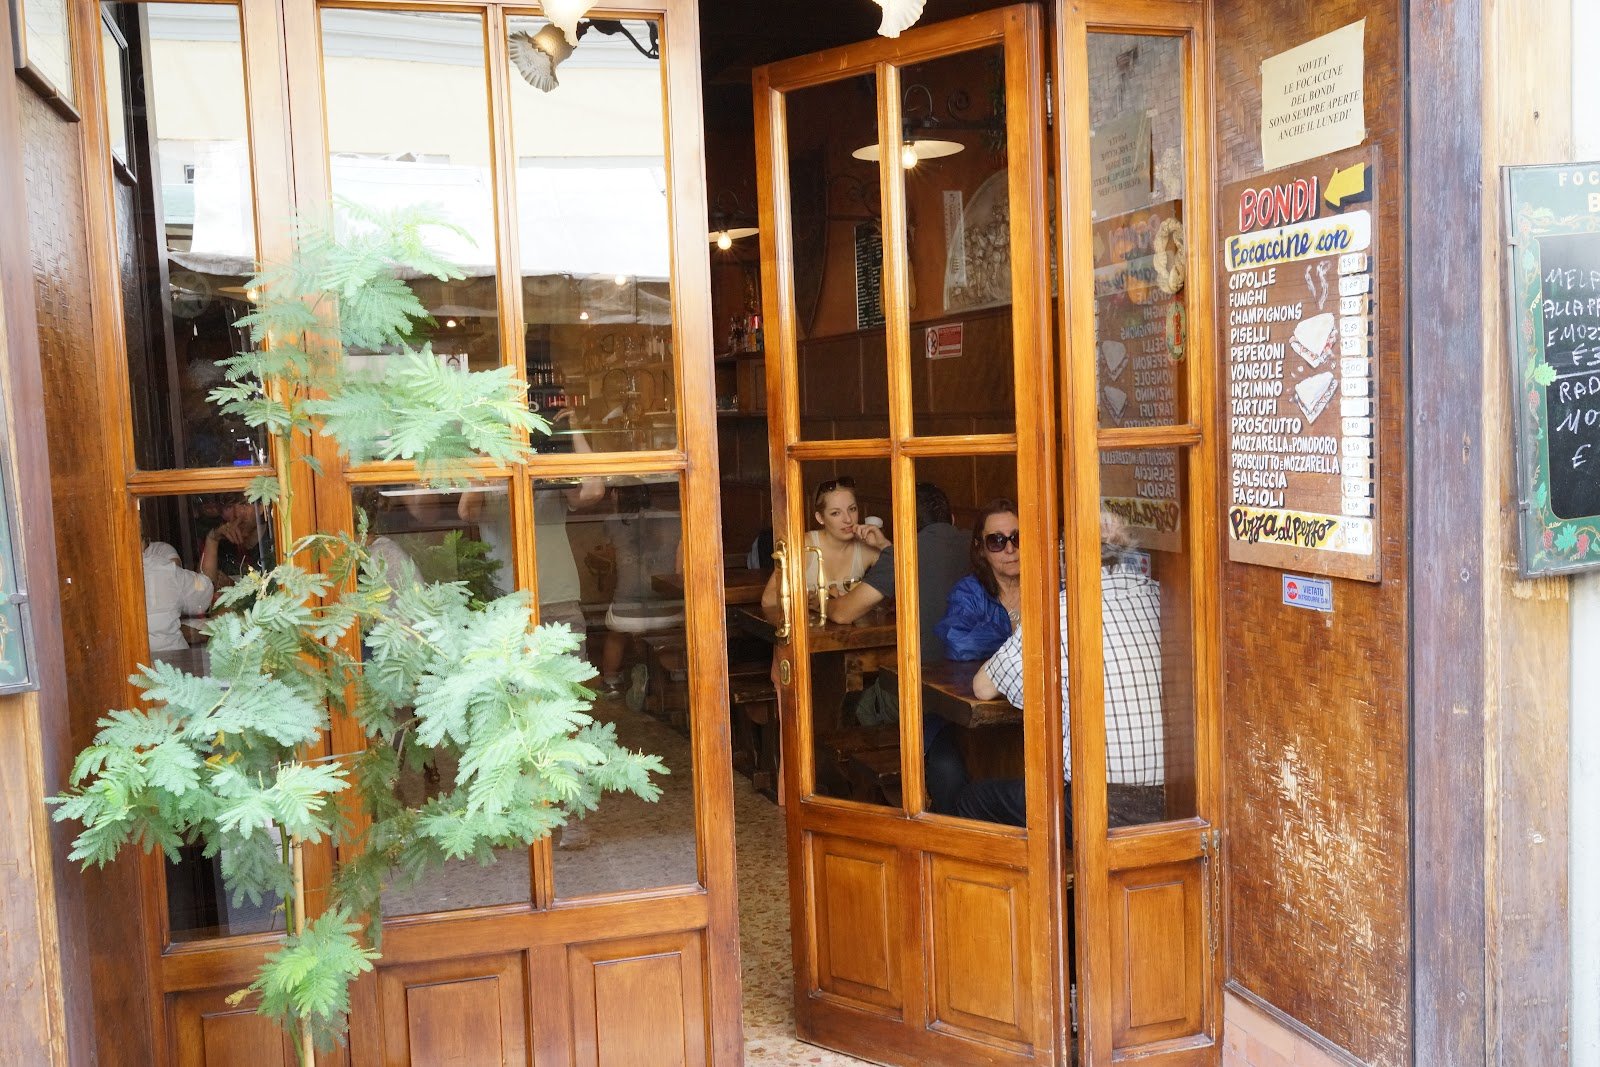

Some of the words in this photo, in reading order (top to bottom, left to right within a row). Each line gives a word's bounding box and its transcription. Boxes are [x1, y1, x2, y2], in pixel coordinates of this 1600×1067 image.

[1297, 54, 1330, 75] NOVITA'
[1284, 82, 1294, 95] LE
[1296, 64, 1344, 91] FOCACCINE
[1291, 93, 1307, 107] DEL
[1309, 83, 1336, 101] BONDI
[1269, 113, 1291, 129] SONO
[1292, 101, 1325, 121] SEMPRE
[1326, 89, 1360, 110] APERTE
[1278, 124, 1305, 141] ANCHE
[1306, 120, 1315, 132] IL
[1239, 176, 1319, 232] BONDI
[1316, 229, 1352, 252] con
[1229, 268, 1276, 290] CIPOLLE
[1229, 290, 1267, 307] FUNGHI
[1230, 302, 1302, 325] CHAMPIGNONS
[1231, 326, 1270, 344] PISELLI
[1231, 343, 1285, 362] PEPERONI
[1231, 361, 1283, 380] VONGOLE
[1232, 381, 1283, 398] INZIMINO
[1232, 399, 1277, 416] TARTUFI
[1232, 417, 1302, 434] PROSCIUTTO
[1232, 435, 1289, 452] MOZZARELLA
[1292, 436, 1338, 455] POMODORO
[1232, 453, 1279, 470] PROSCIUTTO
[1284, 455, 1341, 474] MOZZARELLA
[1232, 470, 1288, 488] SALSICCIA
[1232, 488, 1284, 507] FAGIOLI
[1230, 508, 1278, 544] Pizza
[1275, 515, 1293, 541] al
[1302, 585, 1324, 597] VIETATO
